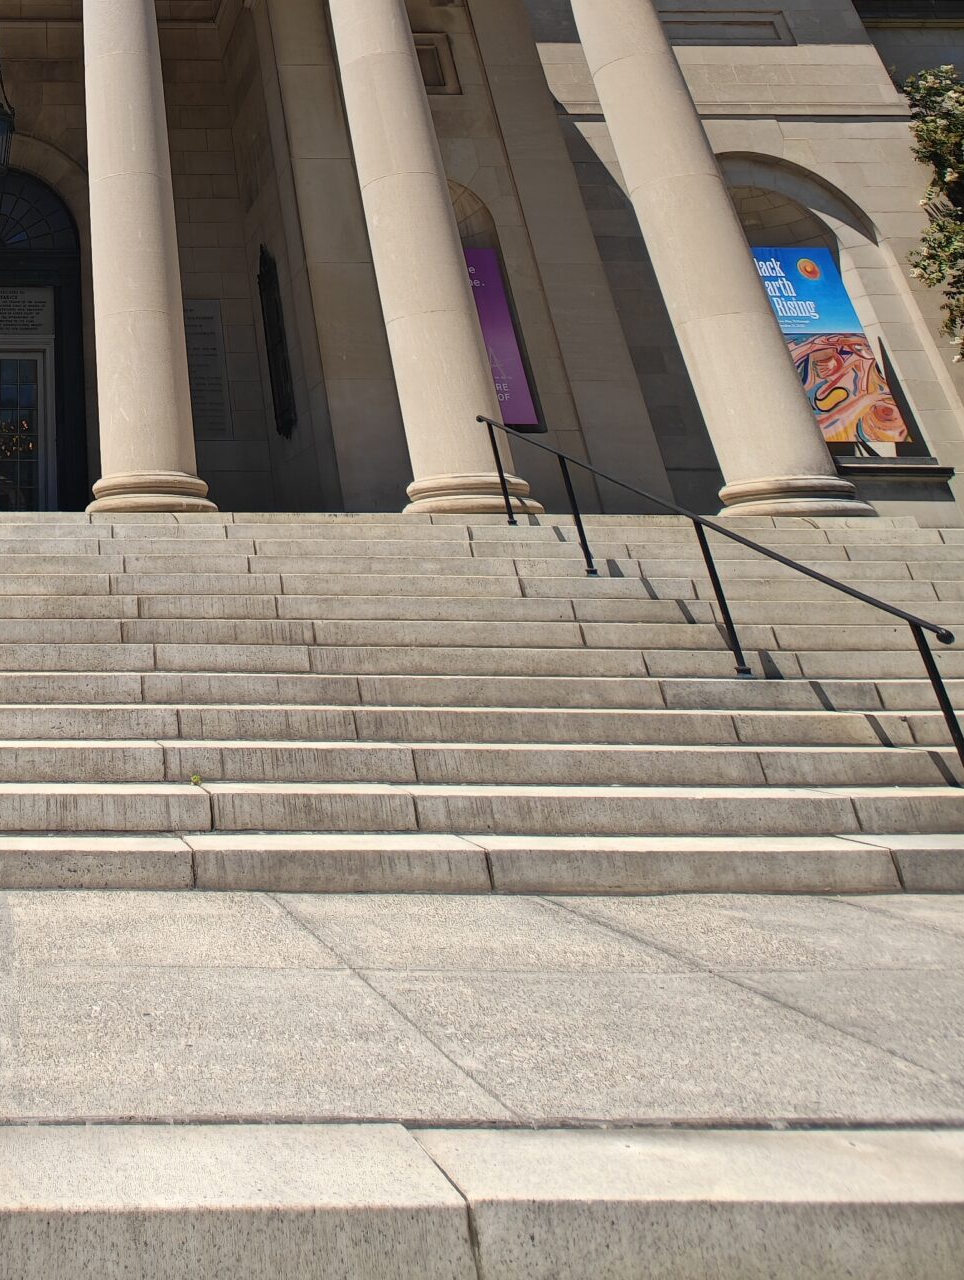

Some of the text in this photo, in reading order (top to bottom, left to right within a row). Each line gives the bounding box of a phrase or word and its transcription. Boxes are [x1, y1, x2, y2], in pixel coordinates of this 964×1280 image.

[468, 266, 476, 274] e
[753, 257, 786, 277] lack
[764, 277, 797, 297] arth
[771, 297, 820, 320] Rising
[495, 383, 509, 391] RE
